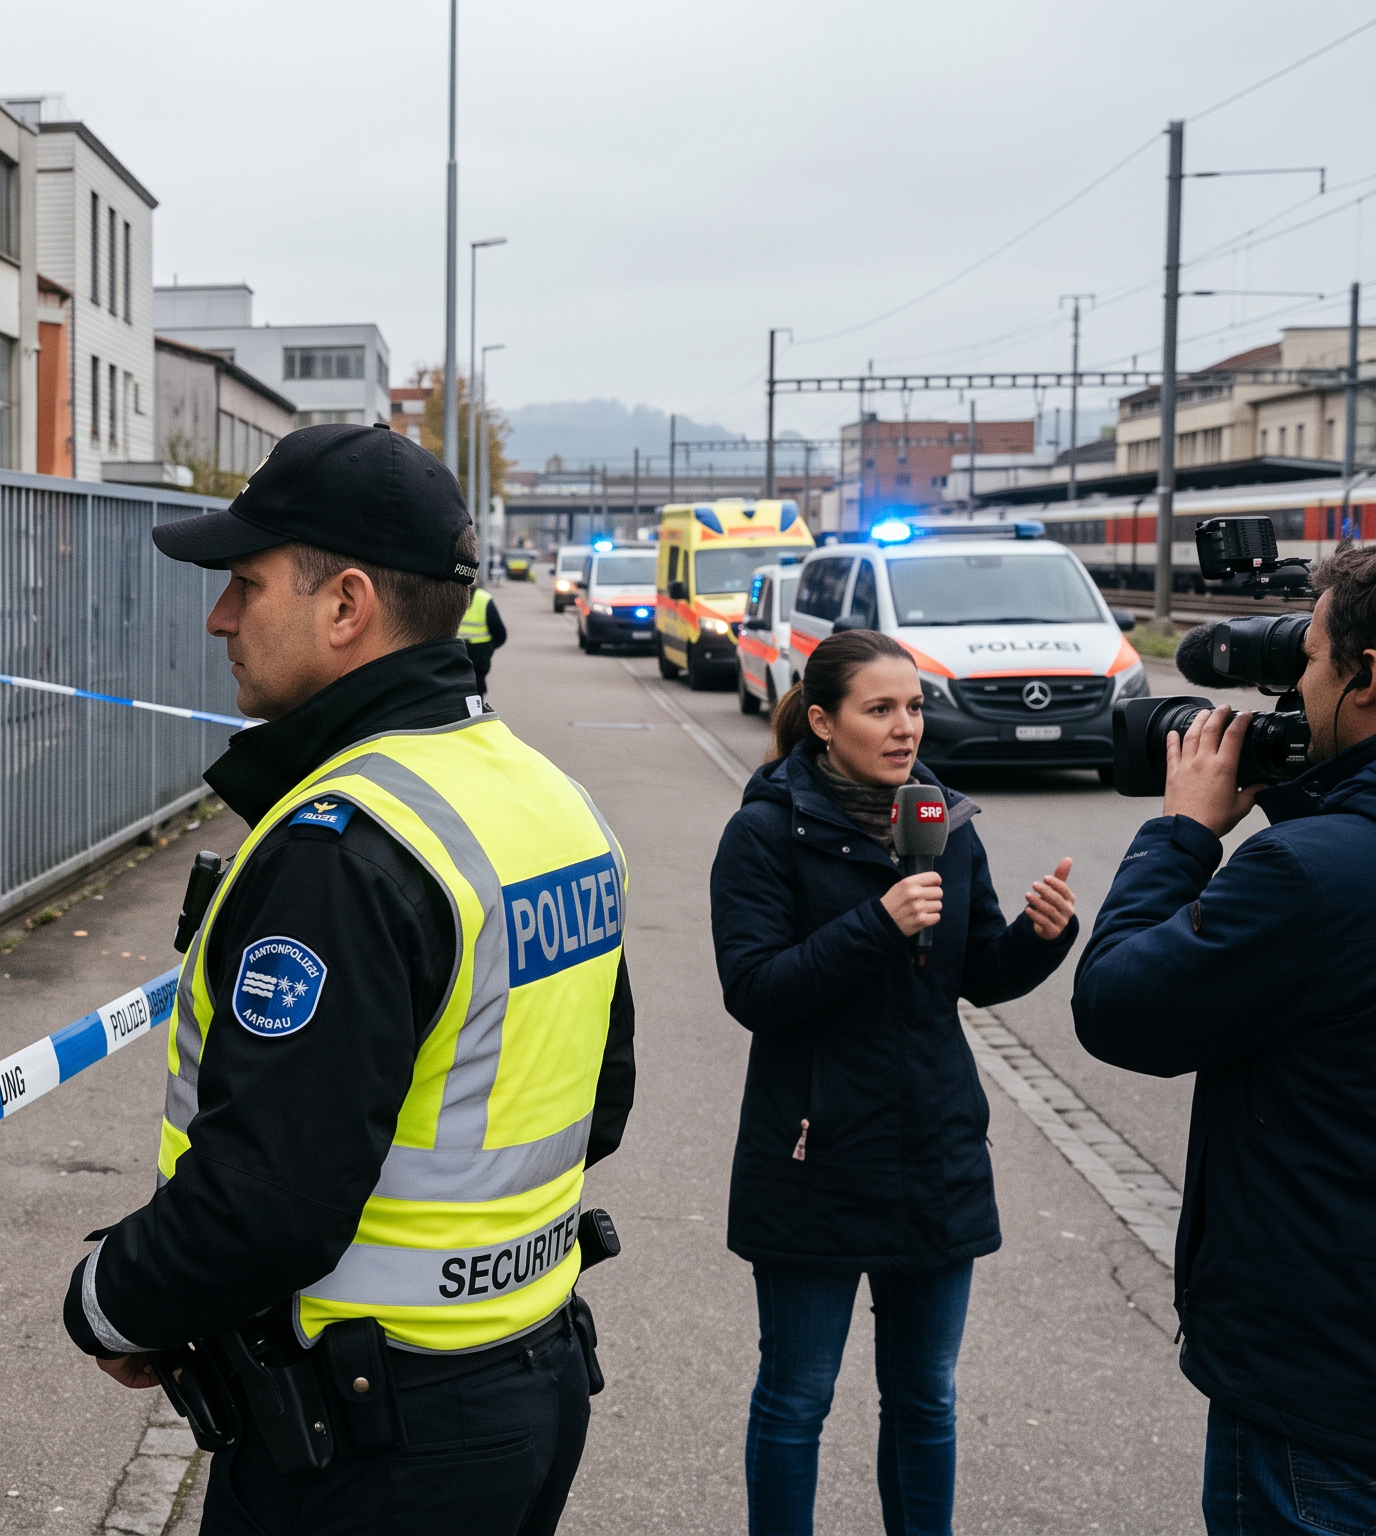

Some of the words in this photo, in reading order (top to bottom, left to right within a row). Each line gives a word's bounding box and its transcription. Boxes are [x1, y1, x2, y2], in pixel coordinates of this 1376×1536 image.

[967, 640, 1082, 654] POLIZEI
[511, 868, 622, 970] POLIZEI
[242, 1008, 291, 1029] AARGAU
